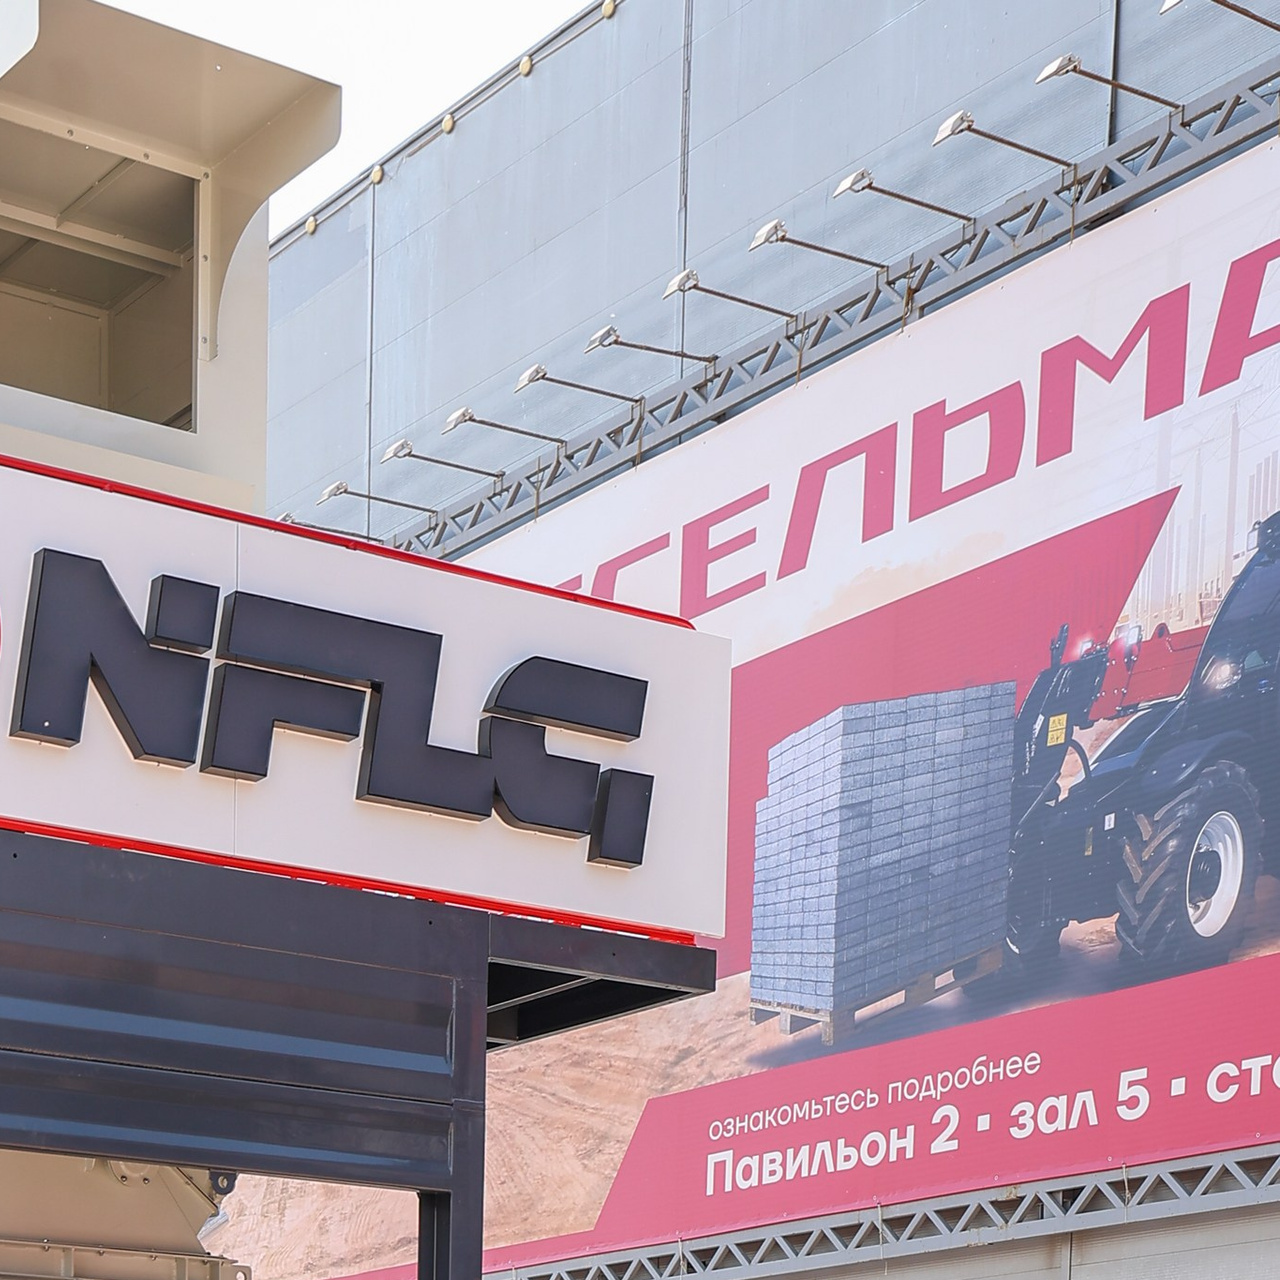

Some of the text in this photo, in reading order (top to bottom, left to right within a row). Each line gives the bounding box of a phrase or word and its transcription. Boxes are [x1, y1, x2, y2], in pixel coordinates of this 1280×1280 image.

[9, 546, 655, 870] NFLG
[705, 1123, 916, 1197] Павильон
[928, 1103, 961, 1157] 2
[1009, 1088, 1099, 1140] зал
[1115, 1066, 1151, 1122] 5
[707, 1050, 1043, 1141] ознакомьтесь подробнее
